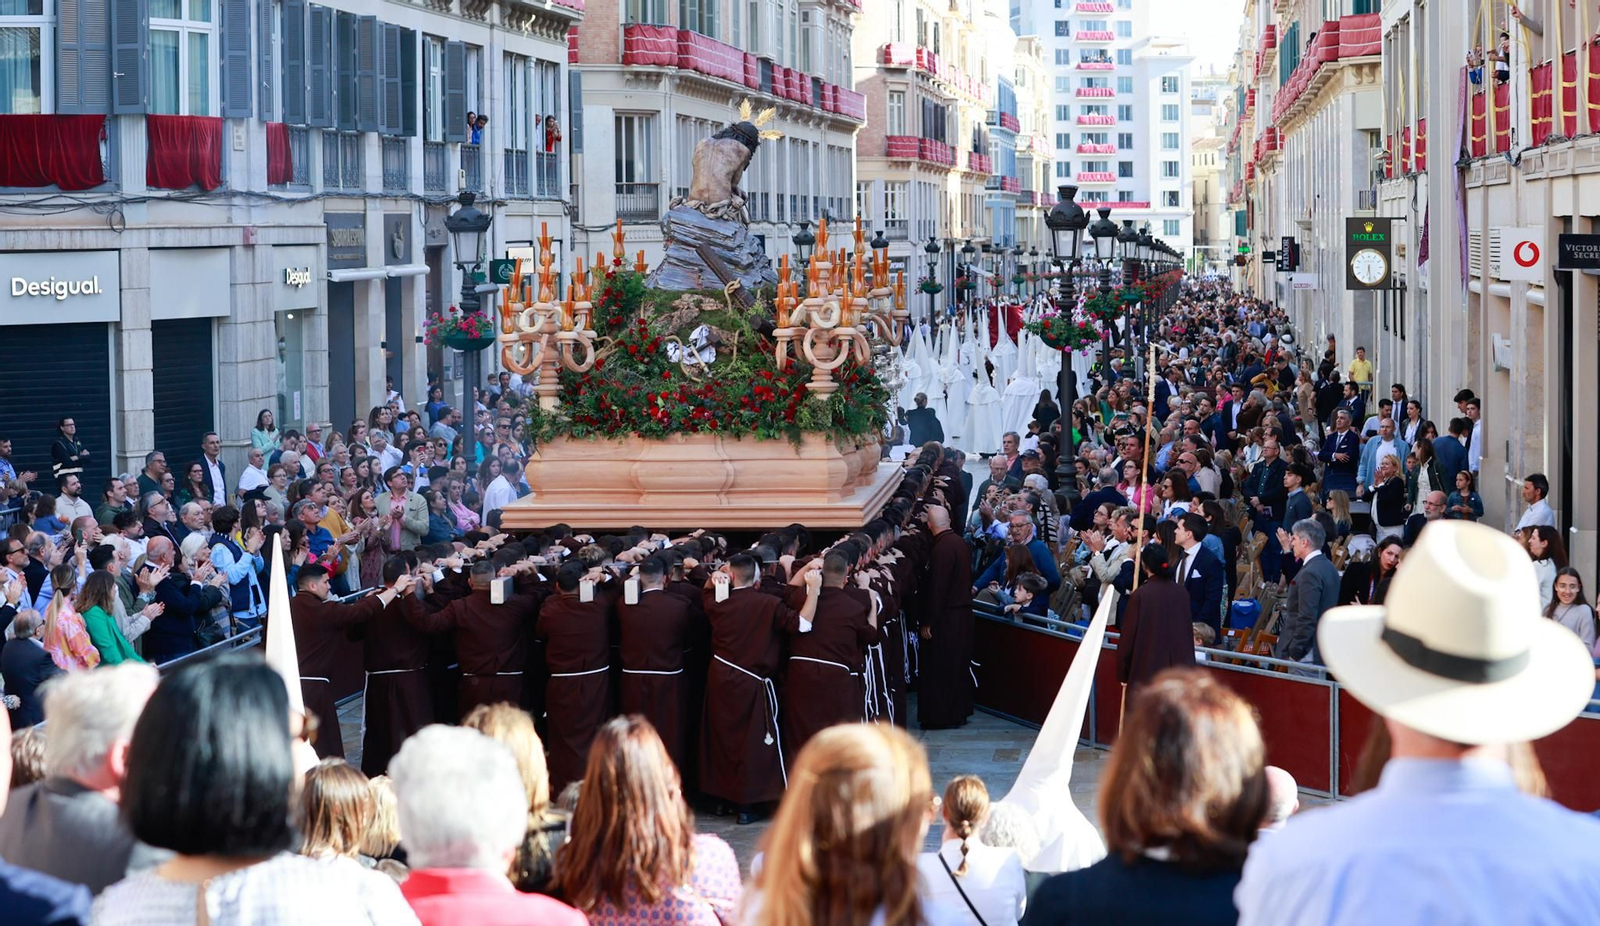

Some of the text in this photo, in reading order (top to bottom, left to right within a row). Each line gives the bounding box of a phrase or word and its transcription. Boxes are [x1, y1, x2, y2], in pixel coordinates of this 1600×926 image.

[1352, 233, 1386, 241] ROLEX
[1282, 238, 1290, 270] PRIMOR
[11, 275, 103, 301] Desigual.
